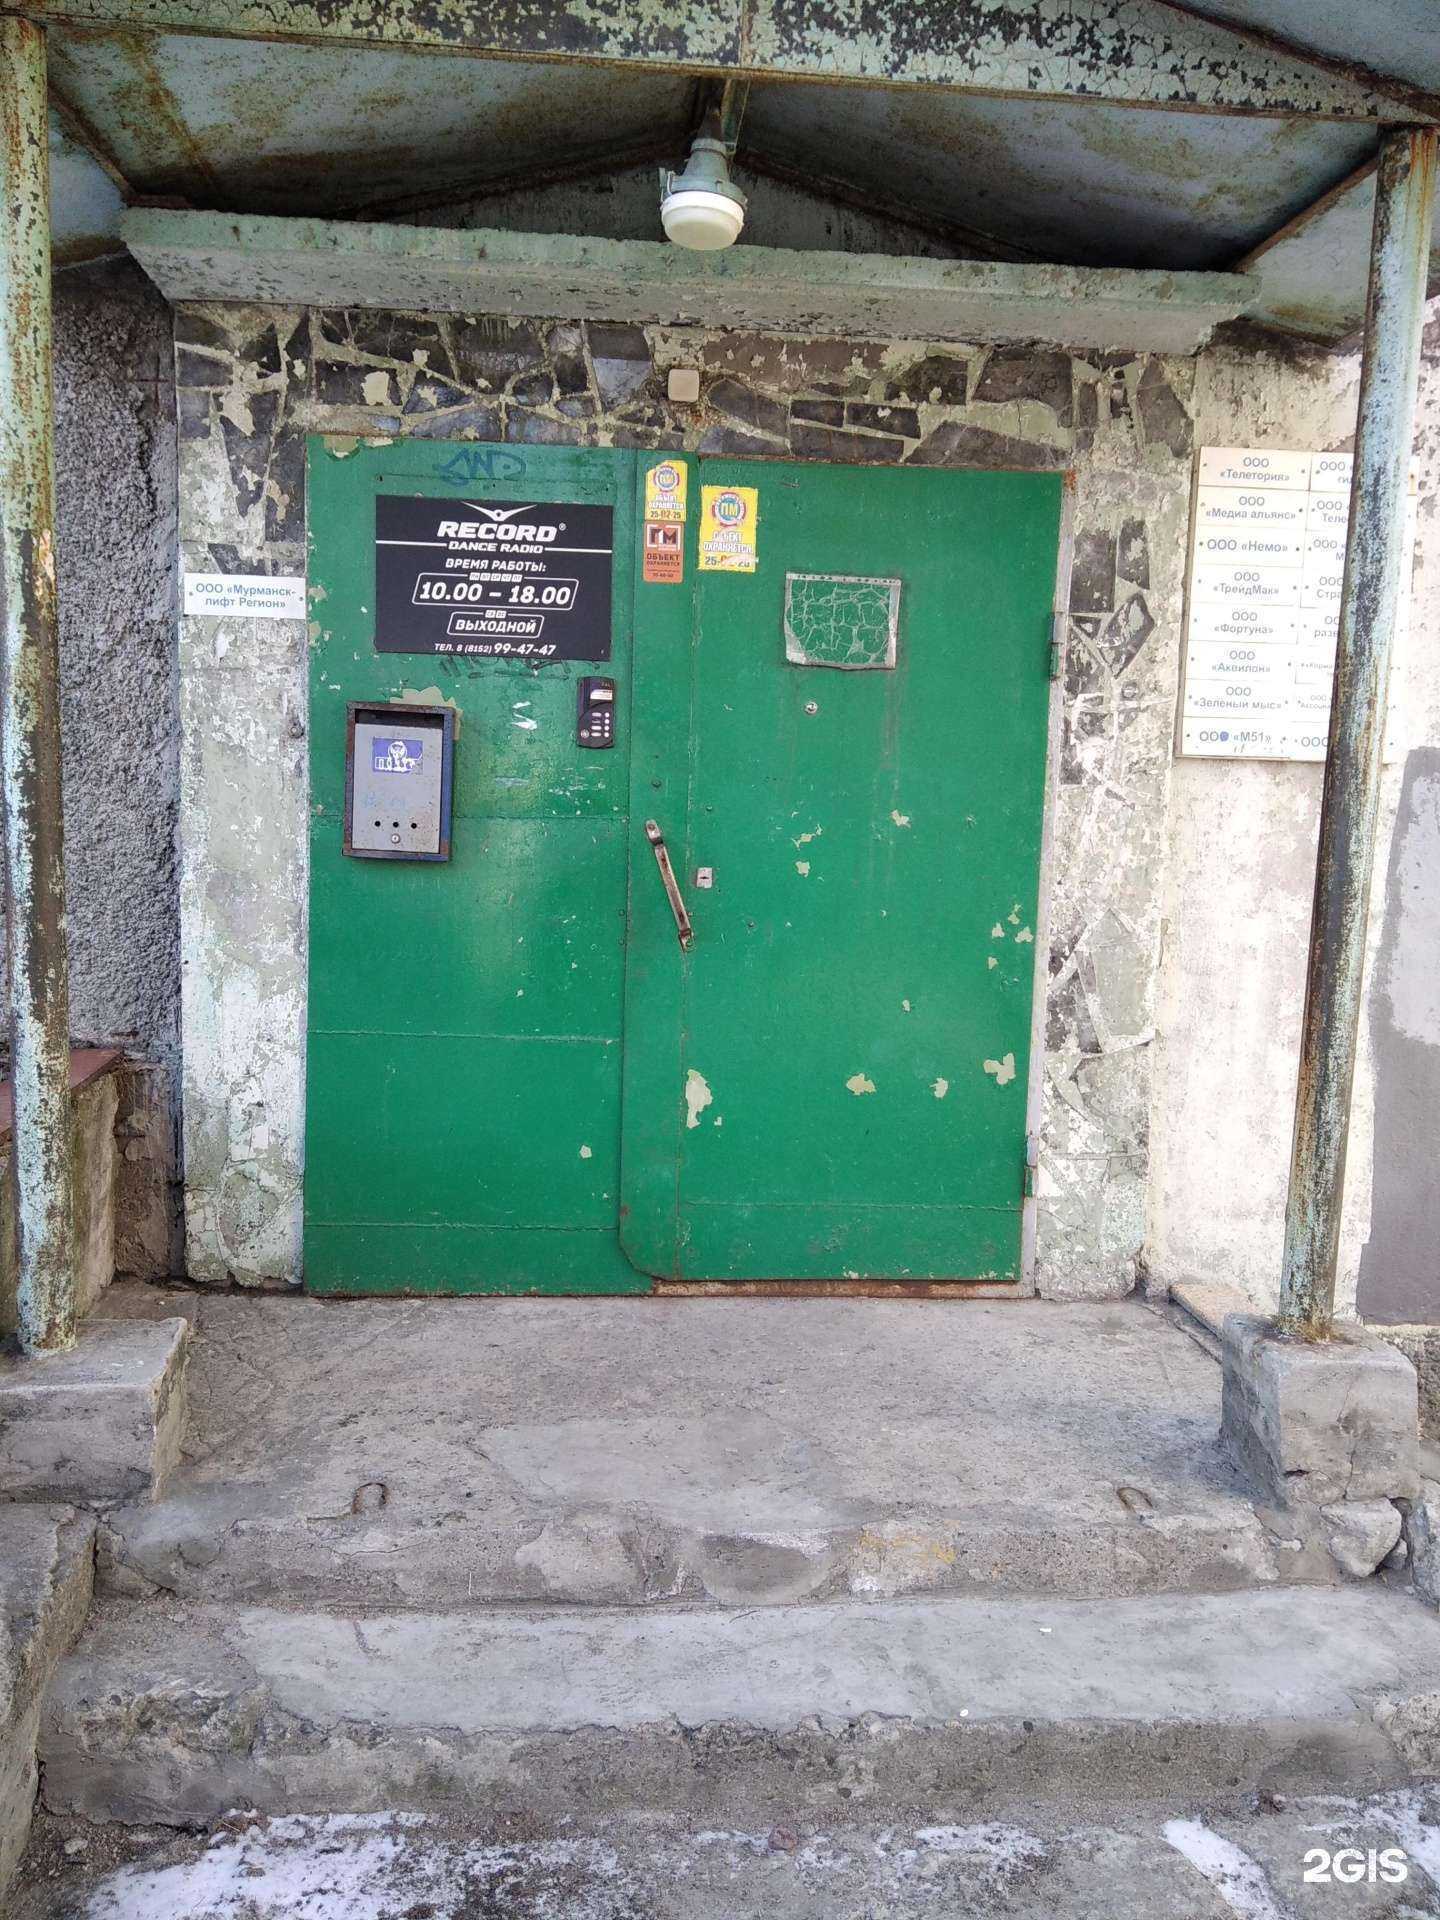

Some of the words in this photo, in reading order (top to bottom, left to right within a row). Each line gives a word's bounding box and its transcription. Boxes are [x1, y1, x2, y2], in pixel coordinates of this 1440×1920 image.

[1243, 456, 1270, 468] ООО
[1320, 461, 1346, 471] ООО
[1220, 468, 1290, 482] «Телетория»
[1239, 496, 1265, 506] ООО
[1316, 500, 1342, 510] ООО
[721, 503, 738, 517] ПМ
[1206, 508, 1248, 520] «Медиа
[1250, 510, 1296, 520] альянс»
[448, 541, 497, 552] DANCE
[500, 543, 543, 554] RADIO
[1207, 539, 1237, 550] ООО
[1241, 540, 1288, 552] «Немо»
[1314, 539, 1338, 549] ООО
[445, 558, 488, 570] ВРЕМЯ
[492, 560, 547, 572] РАБОТЫ:
[1234, 571, 1260, 582] ООО
[196, 583, 223, 594] ООО
[227, 584, 296, 596] «Мурманск-
[419, 581, 482, 601] 10.00
[508, 585, 570, 606] 18.00
[239, 598, 286, 608] Регион»
[1232, 611, 1258, 622] ООО
[455, 619, 537, 634] ВЫХОДНОЙ
[1214, 624, 1274, 636] «Фортуна»
[434, 643, 454, 652] ТЕЛ.
[464, 645, 492, 654] (8152)
[494, 643, 556, 656] 99-47-47
[1230, 650, 1256, 660] ООО
[1226, 686, 1252, 696] ООО
[1233, 731, 1272, 744] «М51»
